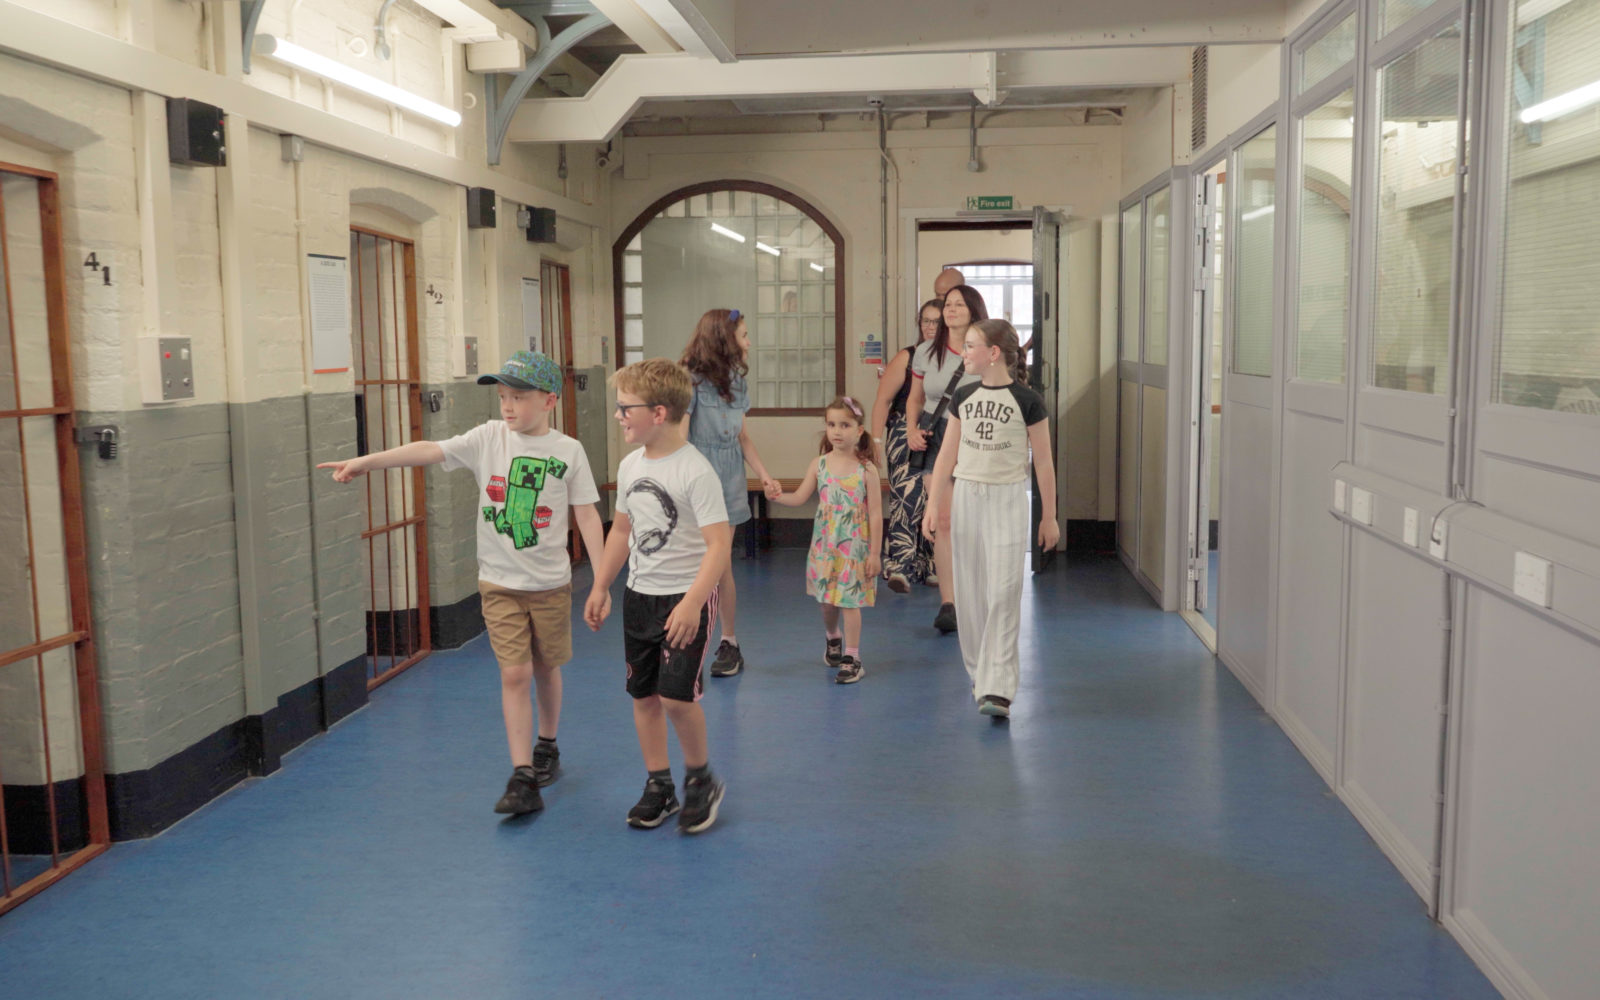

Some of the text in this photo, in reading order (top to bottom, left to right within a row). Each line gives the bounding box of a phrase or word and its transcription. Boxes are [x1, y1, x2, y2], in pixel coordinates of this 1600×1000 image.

[980, 199, 1010, 207] Fire exit
[83, 252, 112, 286] 41
[964, 400, 1014, 424] PARIS
[975, 421, 994, 440] 42
